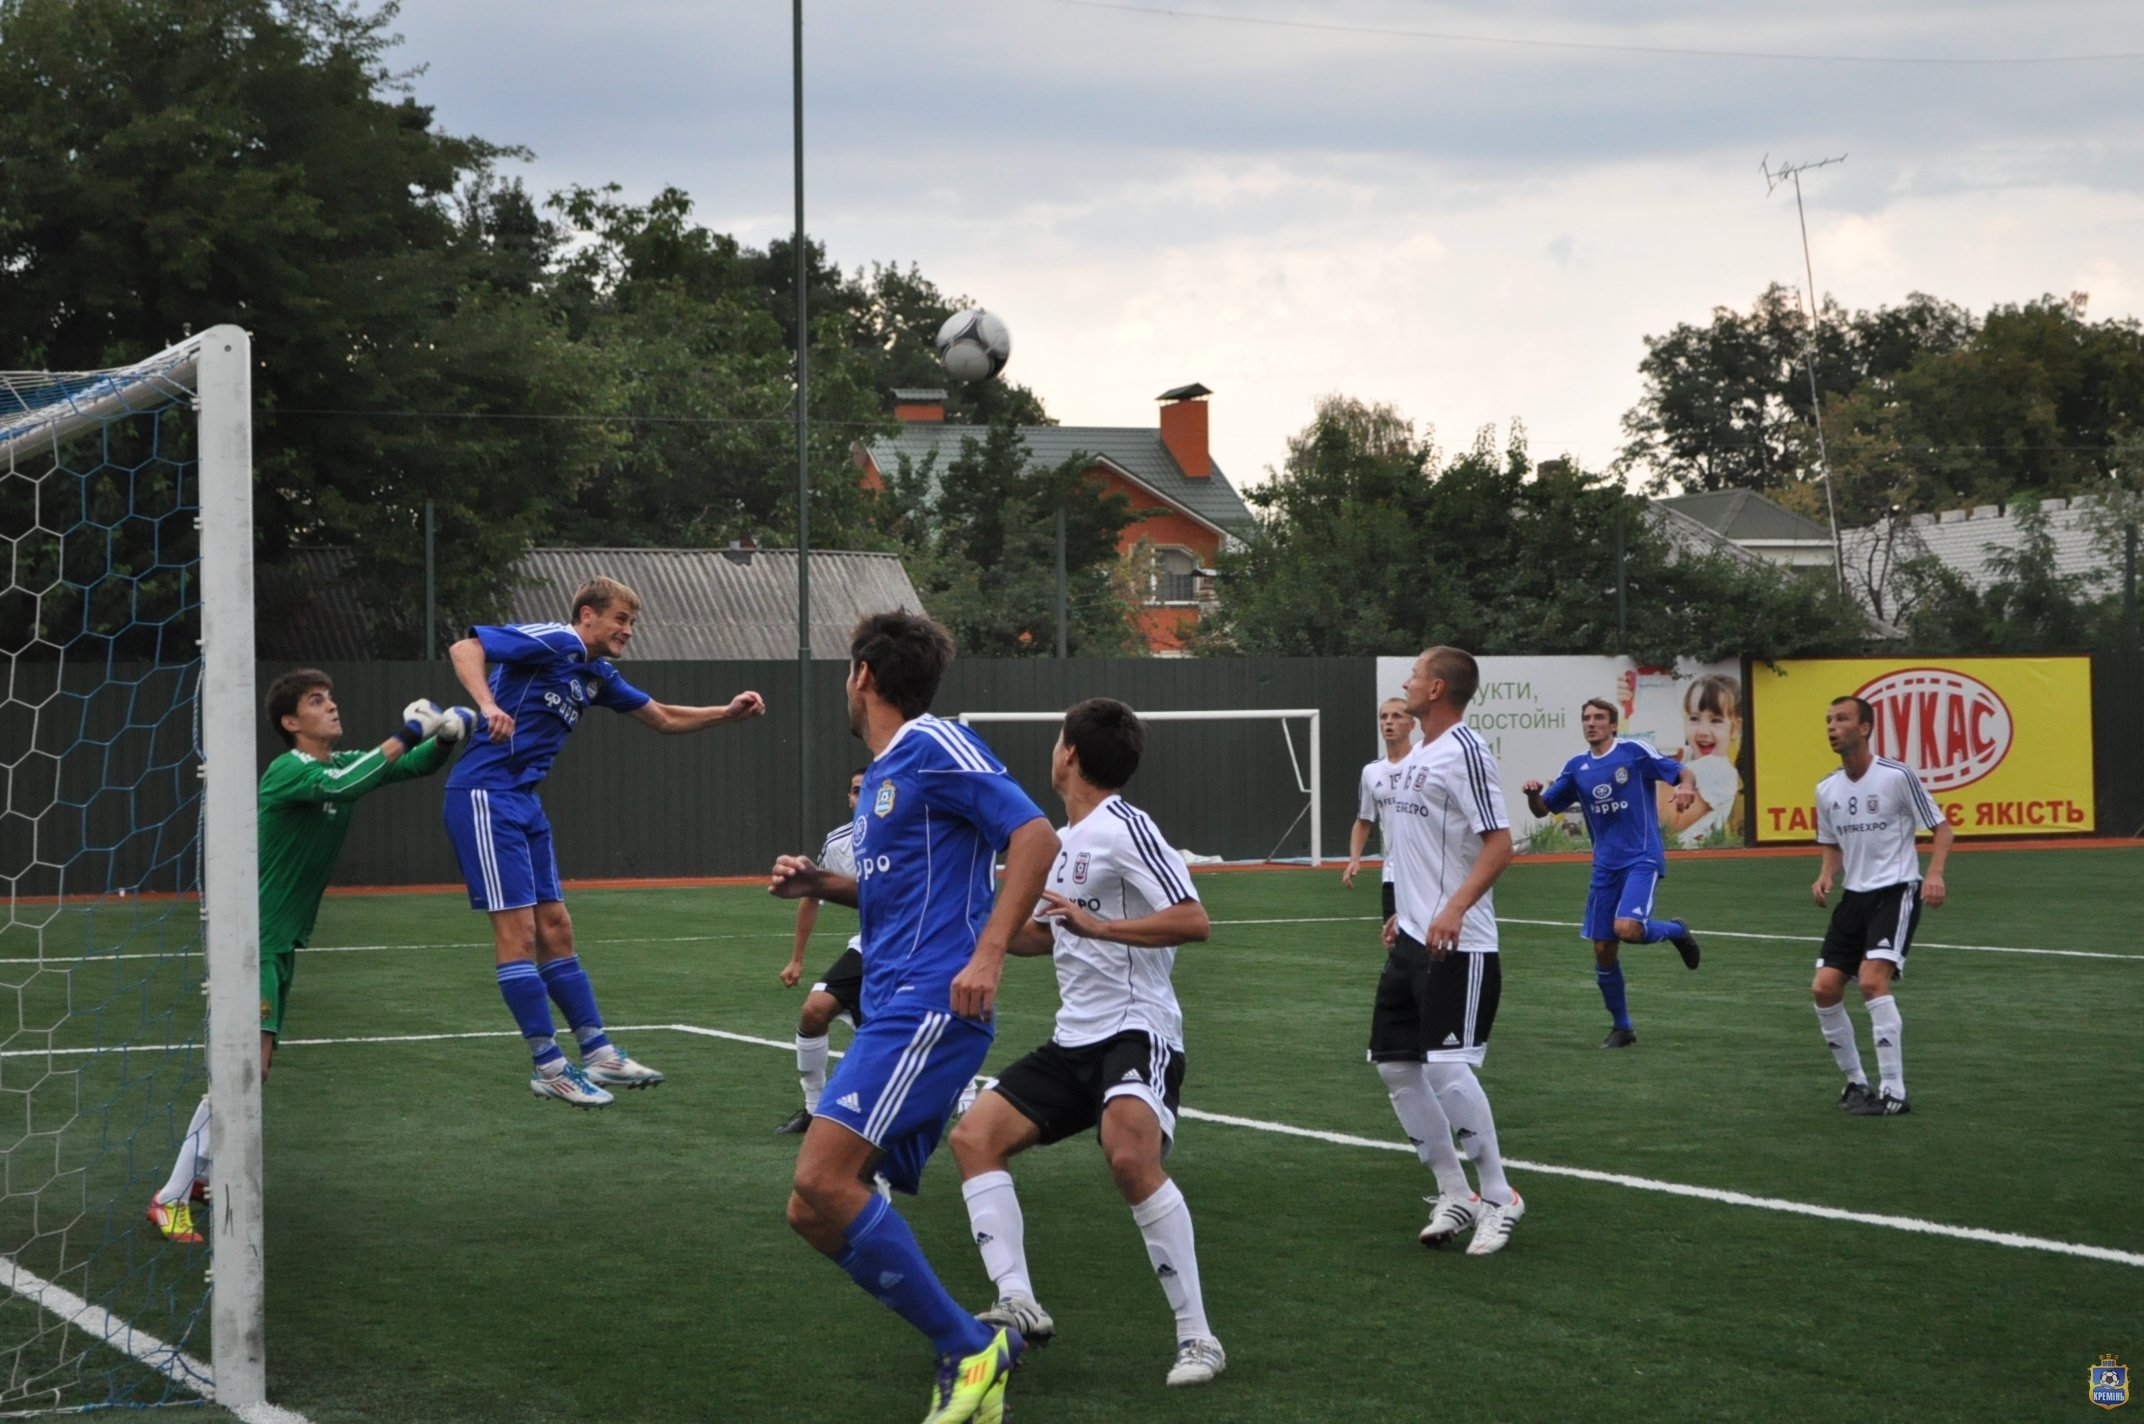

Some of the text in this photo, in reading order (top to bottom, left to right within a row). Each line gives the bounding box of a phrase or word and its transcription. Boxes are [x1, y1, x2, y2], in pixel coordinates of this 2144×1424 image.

[1472, 682, 1538, 706] укти,
[1468, 707, 1565, 733] достойні
[1848, 796, 1858, 815] 8
[1975, 801, 2085, 826] ЯКІСТЬ
[1057, 851, 1067, 883] 2
